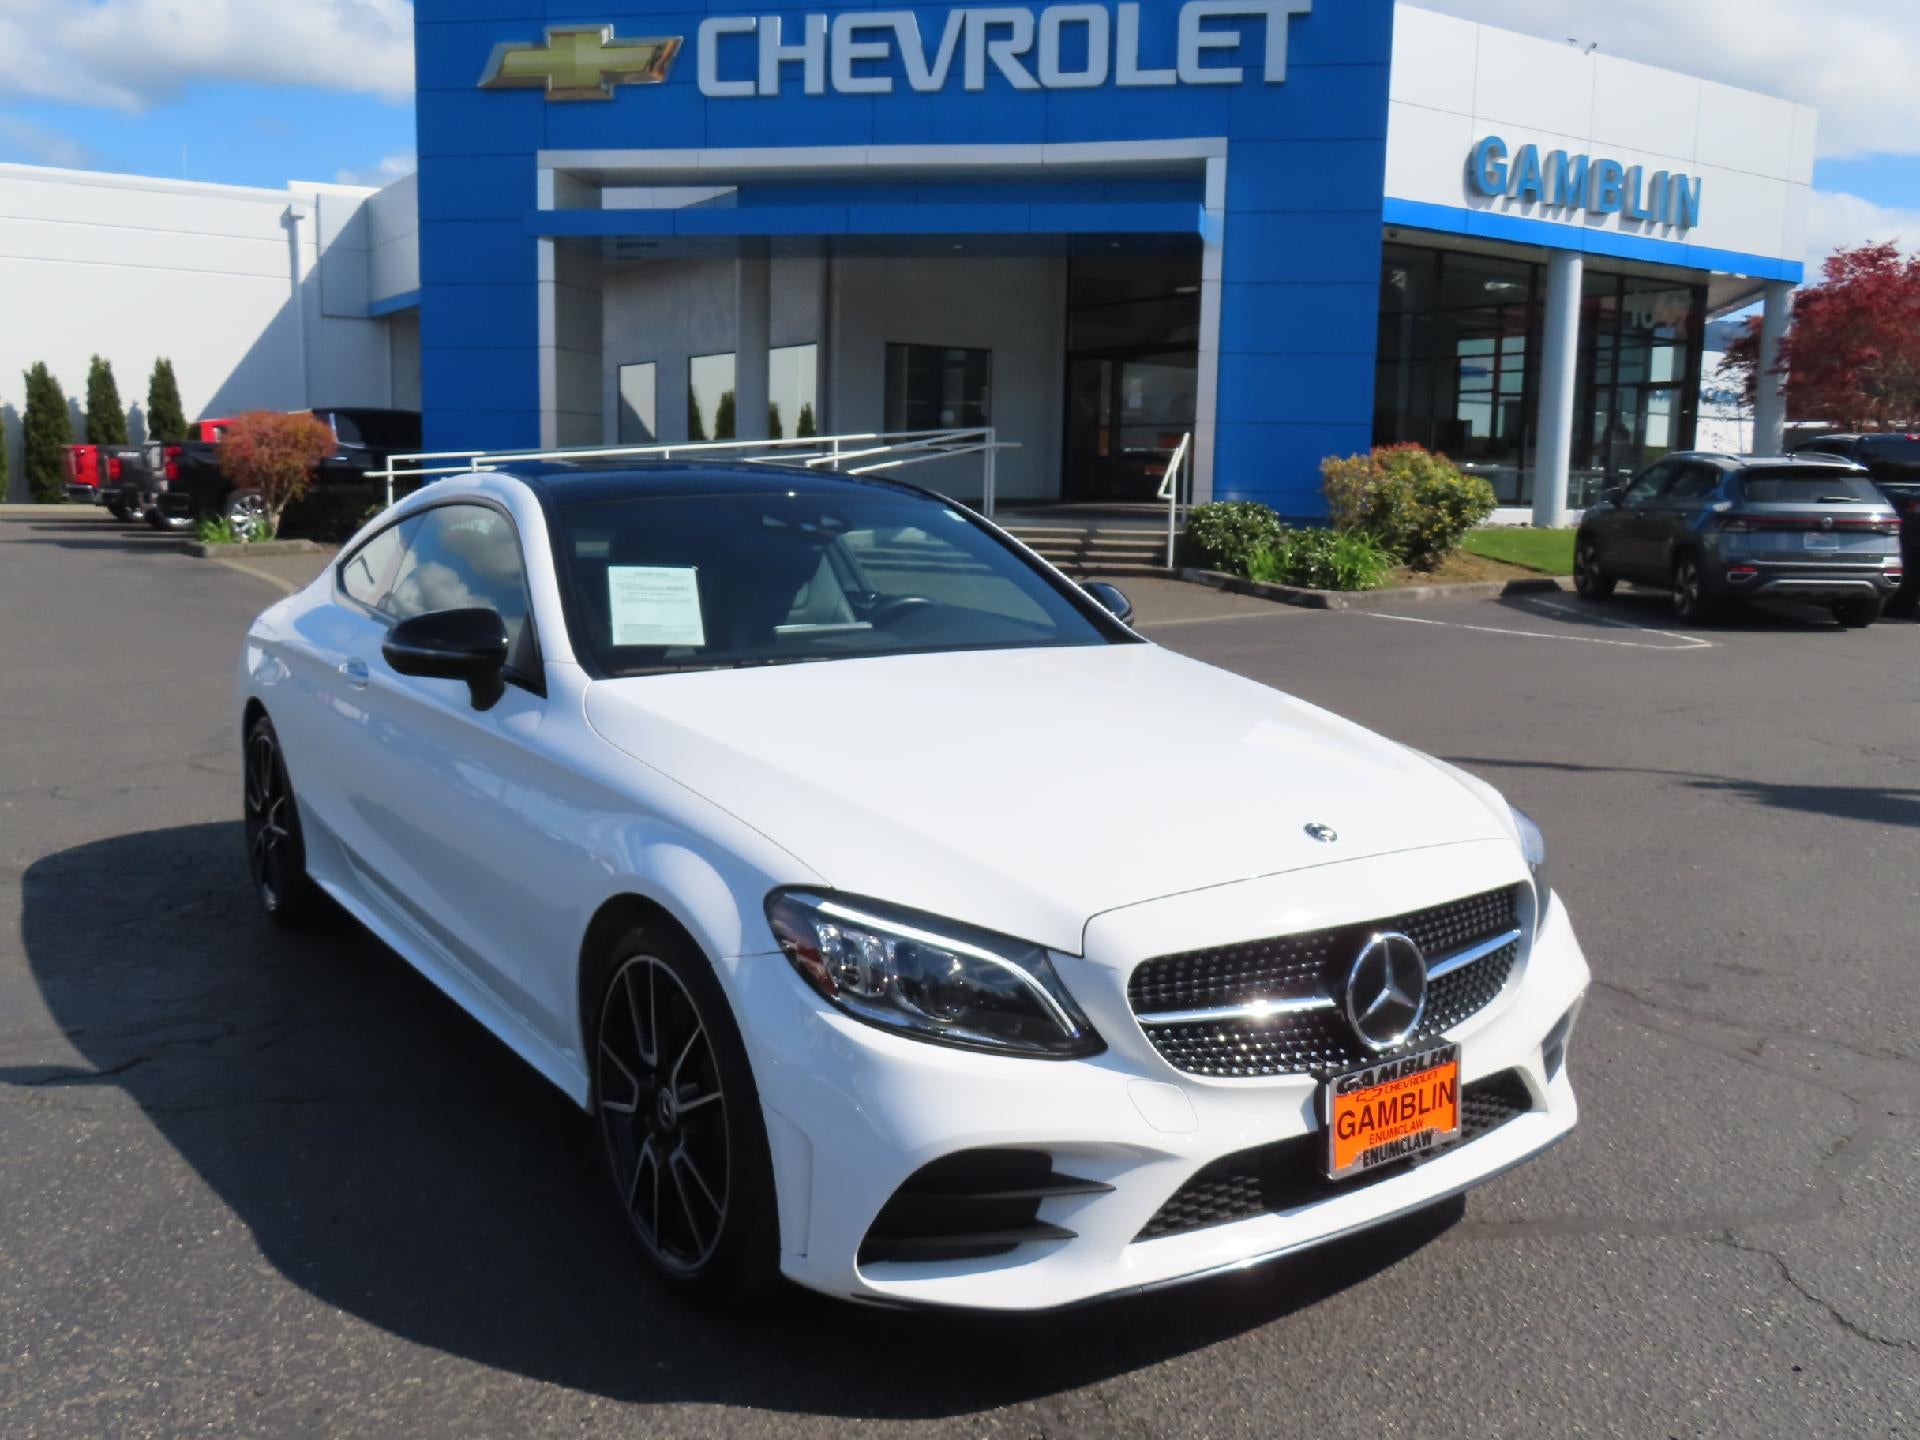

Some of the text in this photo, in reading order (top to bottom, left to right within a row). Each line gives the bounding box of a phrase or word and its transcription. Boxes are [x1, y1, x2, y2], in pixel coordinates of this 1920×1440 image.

[697, 0, 1313, 97] CHEVROLET
[1463, 136, 1701, 228] GAMBLIN
[1336, 1044, 1457, 1094] GAMBLIN
[1384, 1070, 1438, 1094] CHEVROLET
[1336, 1077, 1456, 1140] GAMBLIN
[1369, 1118, 1425, 1145] ENUMCLAW
[1362, 1127, 1434, 1169] ENUMCLAW
